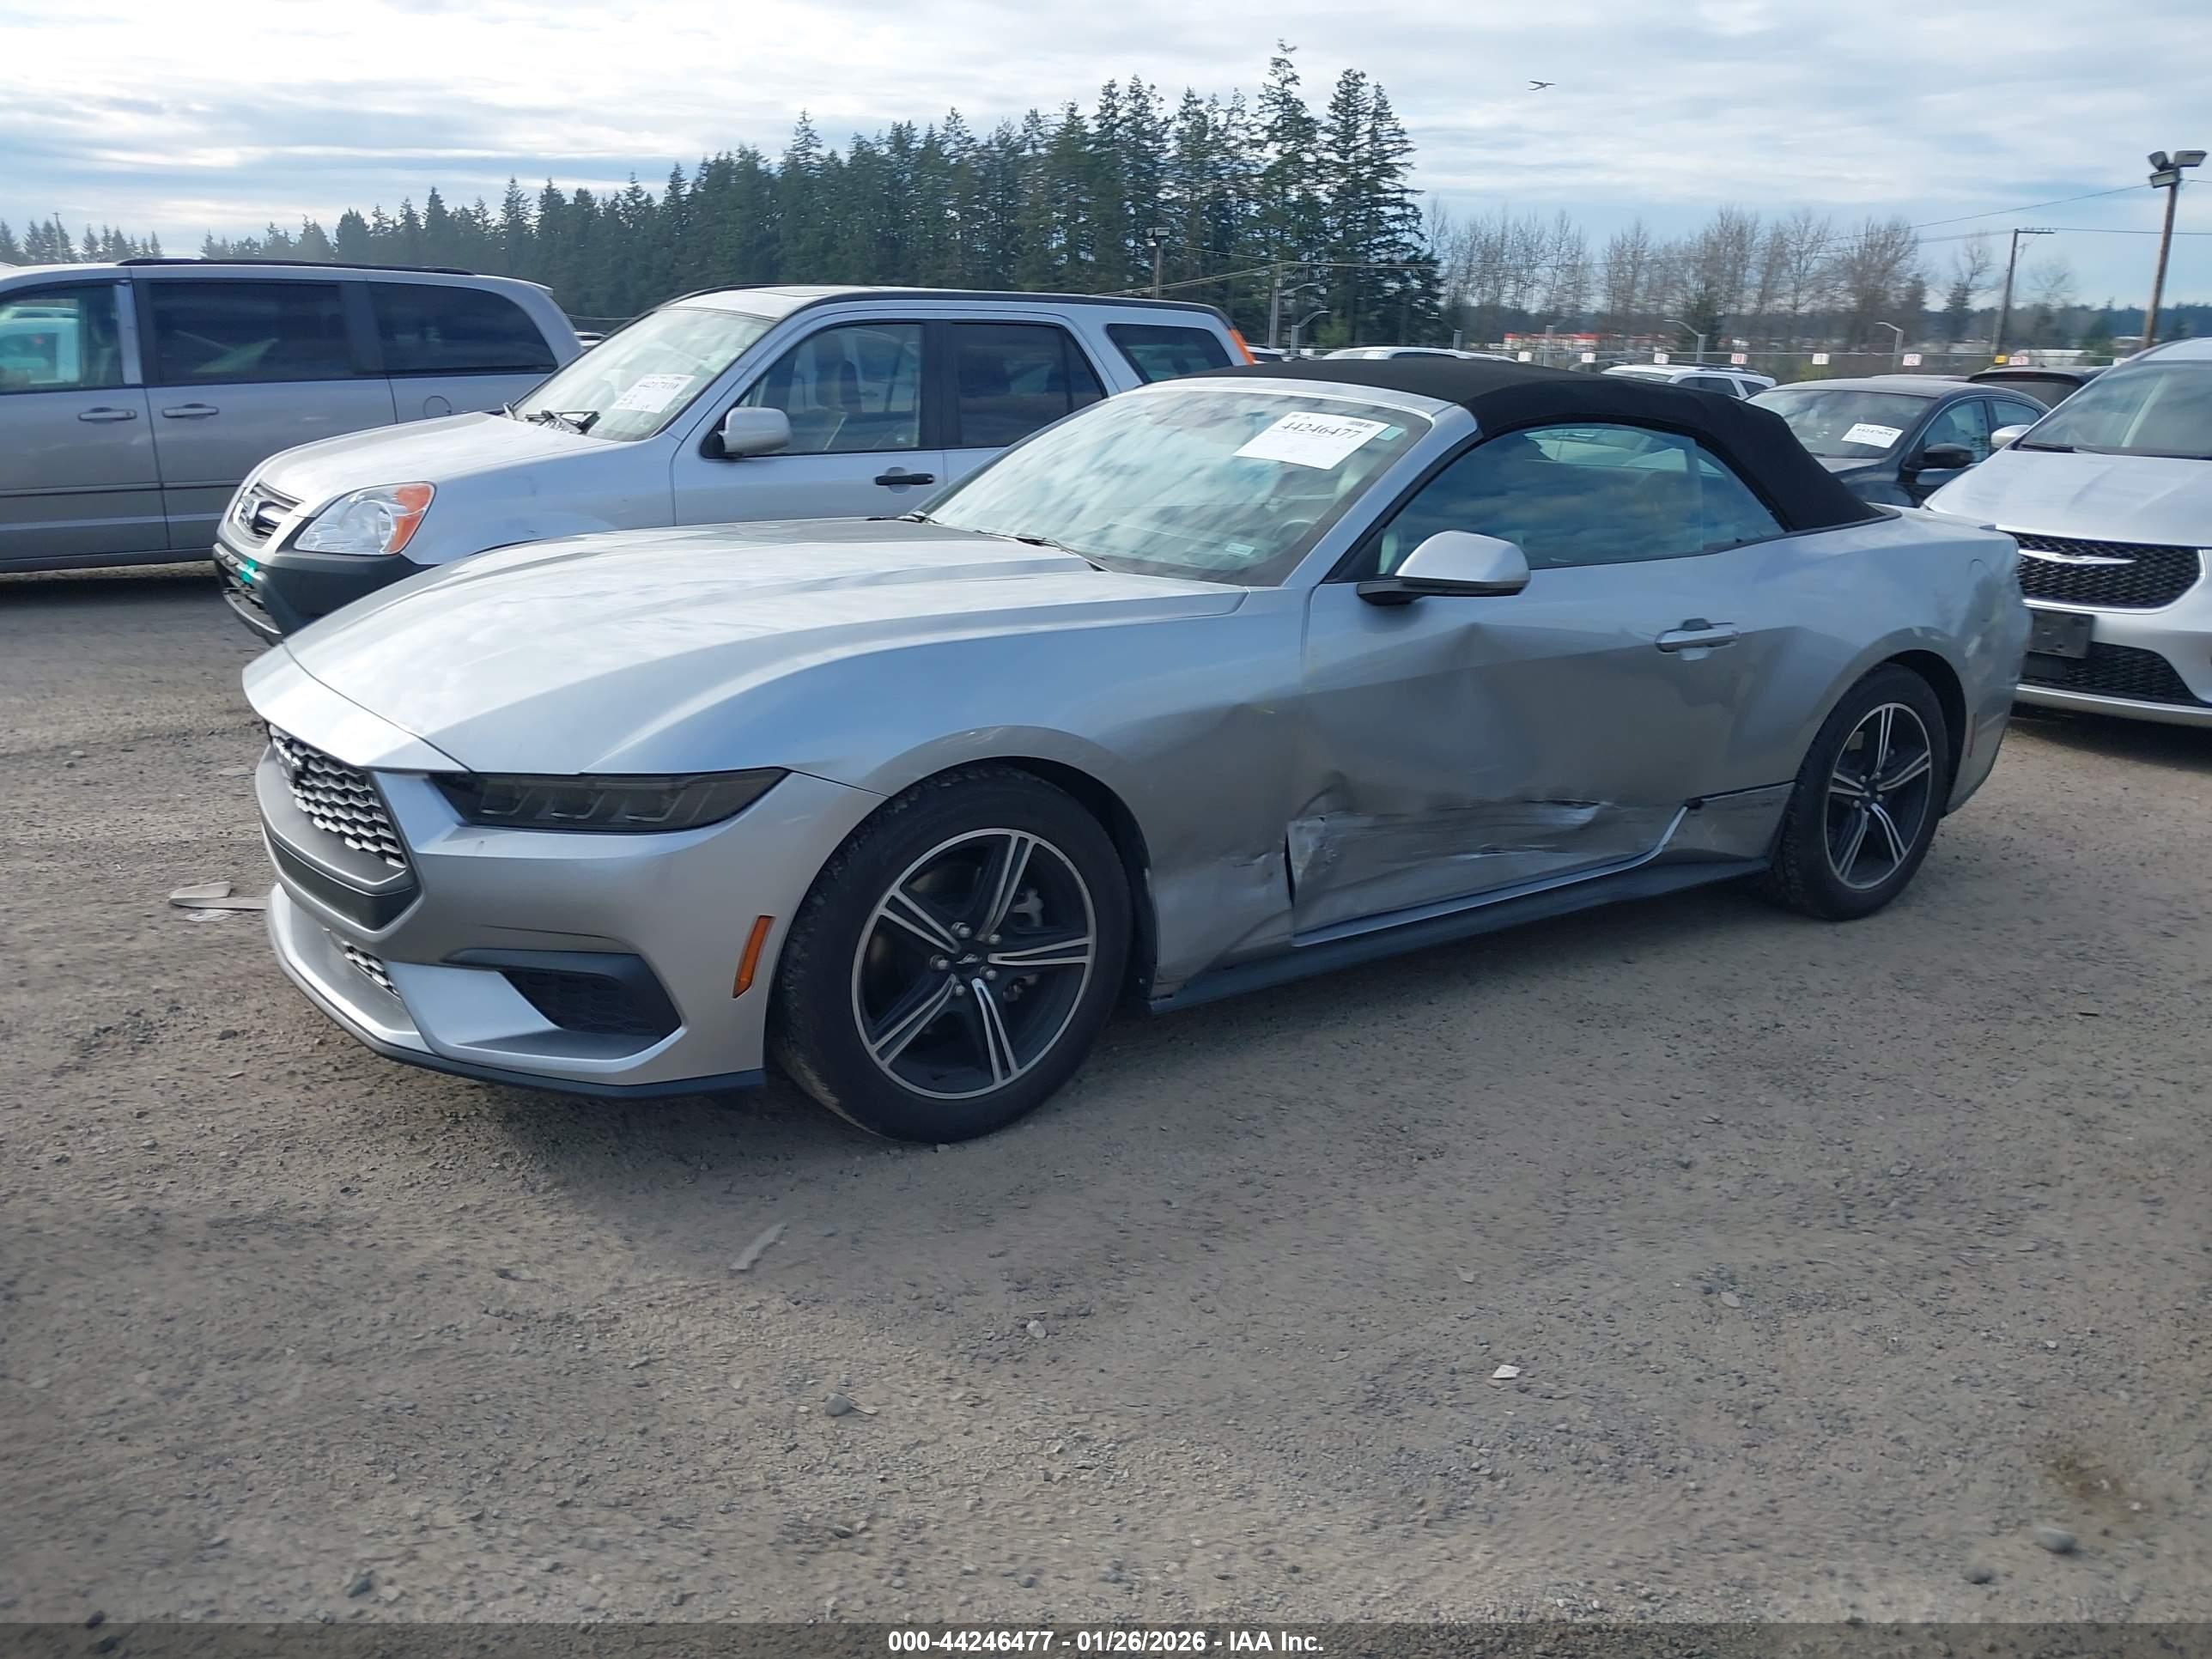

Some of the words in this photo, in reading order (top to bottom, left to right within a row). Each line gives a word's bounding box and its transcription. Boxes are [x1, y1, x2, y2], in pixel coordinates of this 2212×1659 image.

[1732, 353, 1742, 363] 10
[1905, 355, 1917, 365] 12
[1280, 421, 1364, 439] 44246477
